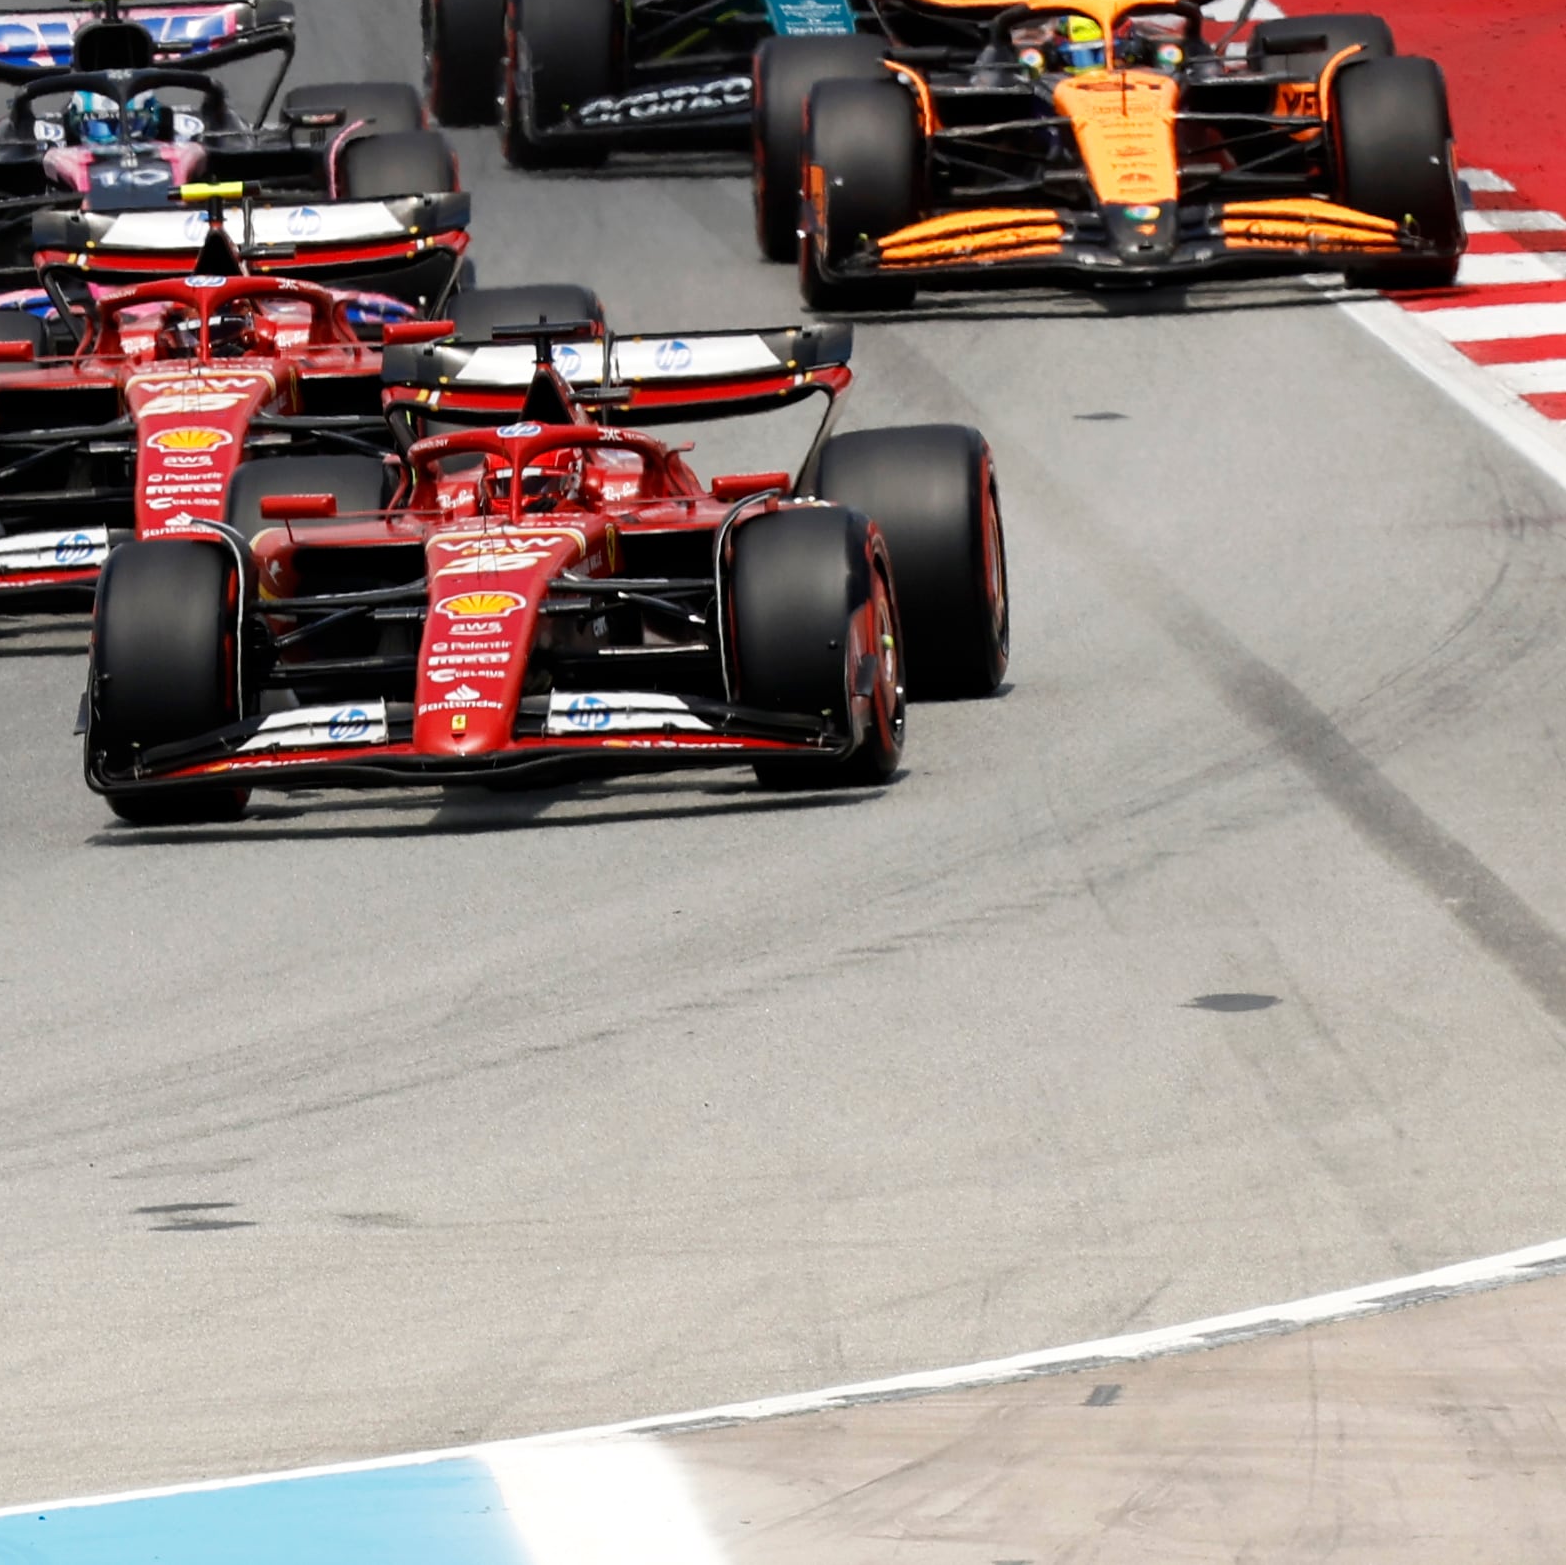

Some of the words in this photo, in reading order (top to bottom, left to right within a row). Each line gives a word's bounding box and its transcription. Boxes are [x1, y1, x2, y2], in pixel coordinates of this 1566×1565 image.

[654, 340, 693, 373] hp
[163, 455, 214, 468] aws
[141, 525, 219, 541] Santande
[448, 620, 503, 636] aws
[450, 640, 513, 652] Palantir
[417, 697, 504, 716] Santander
[566, 695, 612, 729] hp
